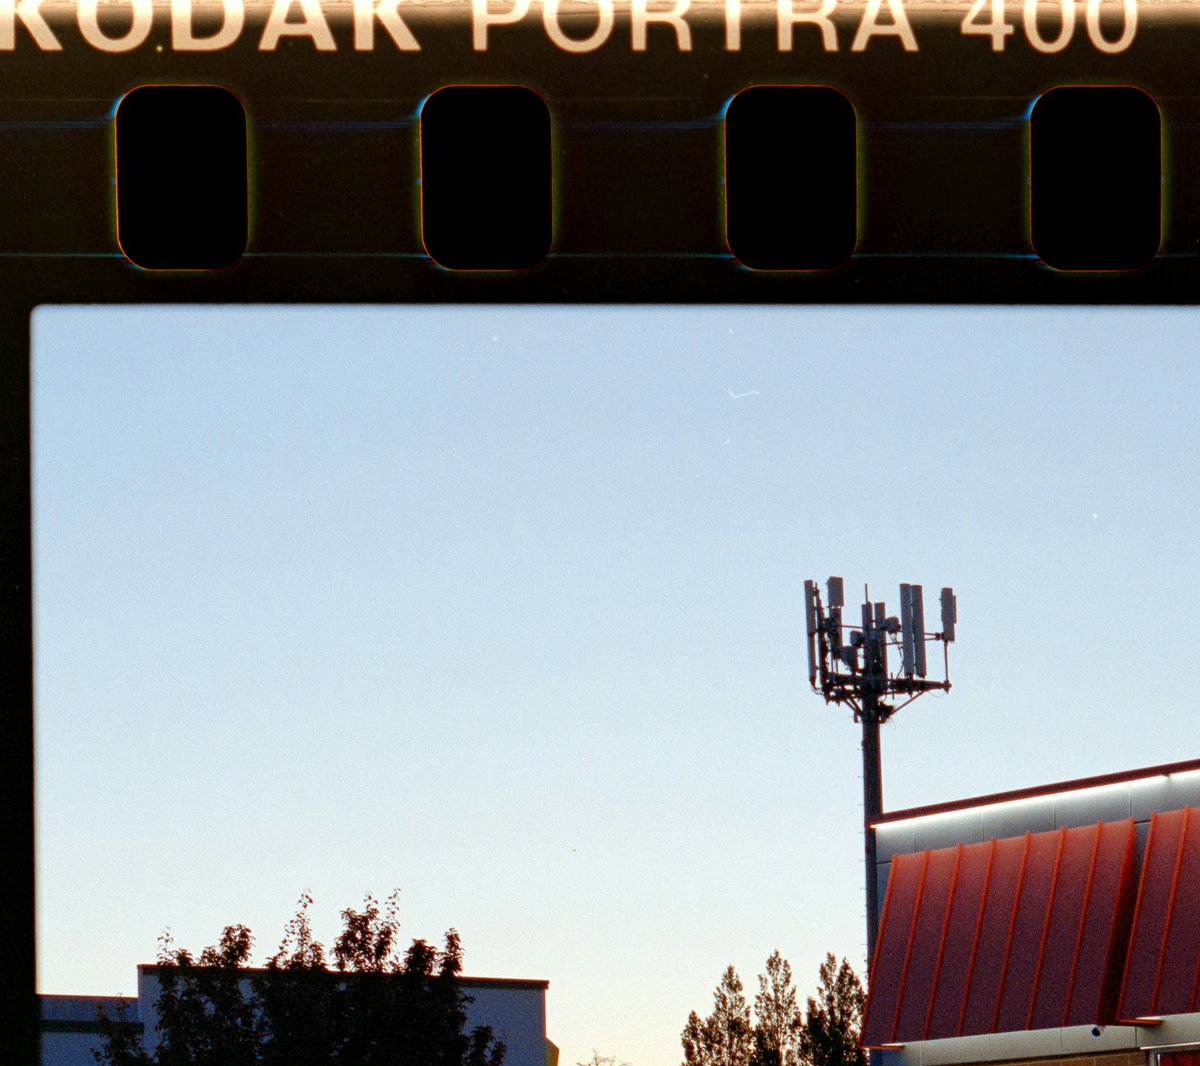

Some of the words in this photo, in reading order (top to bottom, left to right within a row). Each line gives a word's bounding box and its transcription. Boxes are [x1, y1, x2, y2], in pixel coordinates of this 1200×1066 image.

[0, 0, 421, 52] KODAK
[472, 0, 919, 53] PORTRA
[961, 0, 1138, 53] 400
